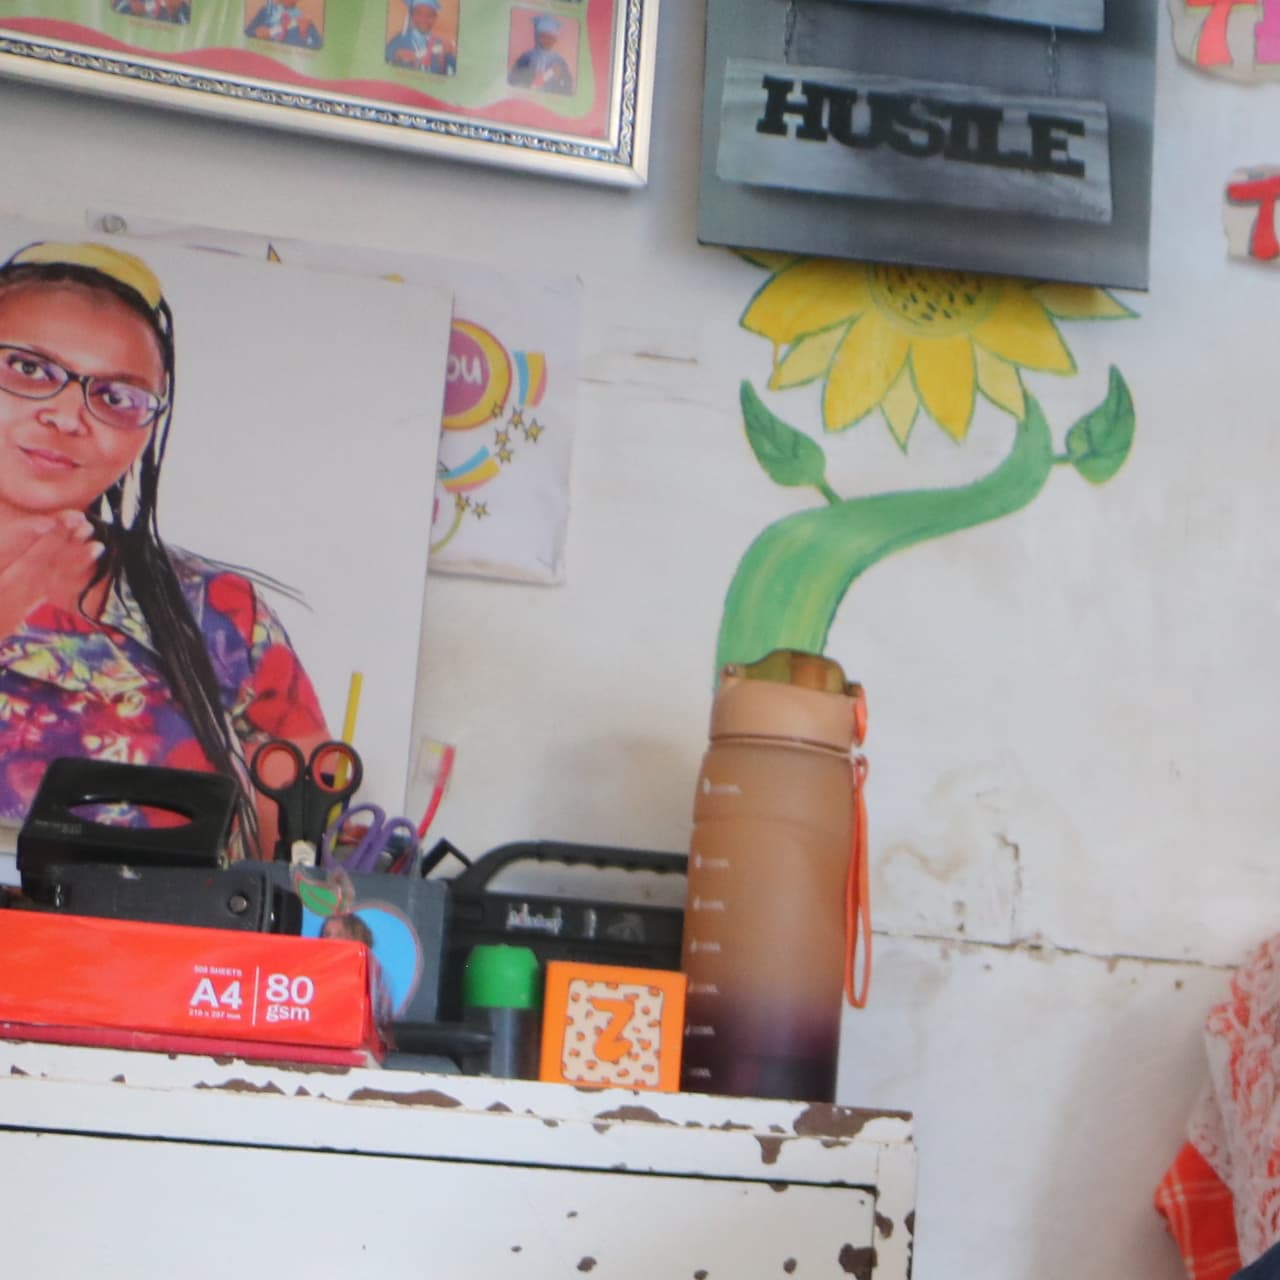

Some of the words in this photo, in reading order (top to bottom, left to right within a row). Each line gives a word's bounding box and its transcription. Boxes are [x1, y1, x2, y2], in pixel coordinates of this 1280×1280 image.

[447, 353, 483, 385] ou
[189, 977, 243, 1010] A4
[265, 972, 316, 1005] 80
[265, 1003, 311, 1023] gsm
